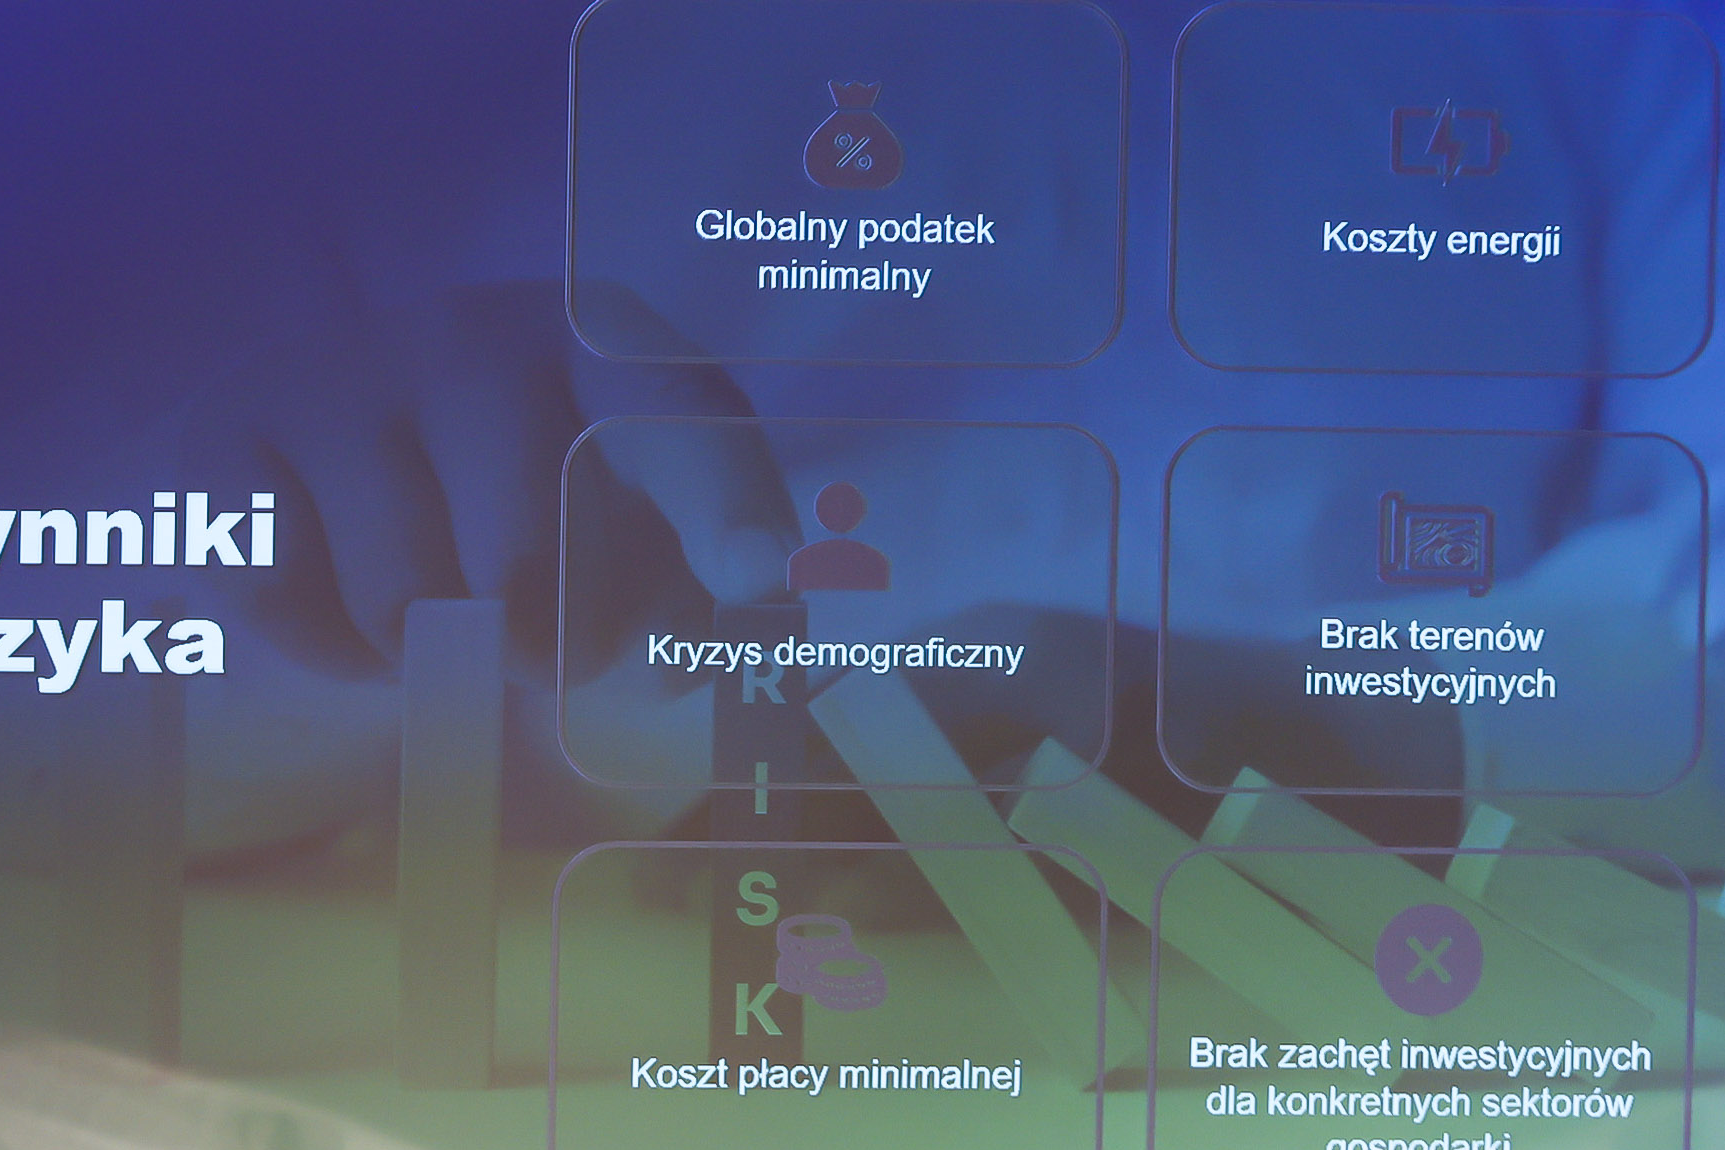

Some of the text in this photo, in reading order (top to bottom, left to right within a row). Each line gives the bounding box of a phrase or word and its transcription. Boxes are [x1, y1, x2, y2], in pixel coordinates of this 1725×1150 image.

[695, 208, 996, 250] Globalny podatek
[1322, 220, 1561, 264] Koszty energii
[757, 258, 933, 298] minimalny
[647, 633, 1026, 675] Kryzys demograficzny
[1320, 617, 1546, 652] Brak terenów
[1305, 664, 1557, 706] inwestycyjnych
[631, 1056, 1022, 1097] Koszt płacy minimalnej
[1189, 1036, 1652, 1079] Brak zachęt inwestycyjnych
[1205, 1084, 1635, 1124] dla konkretnych sektorów
